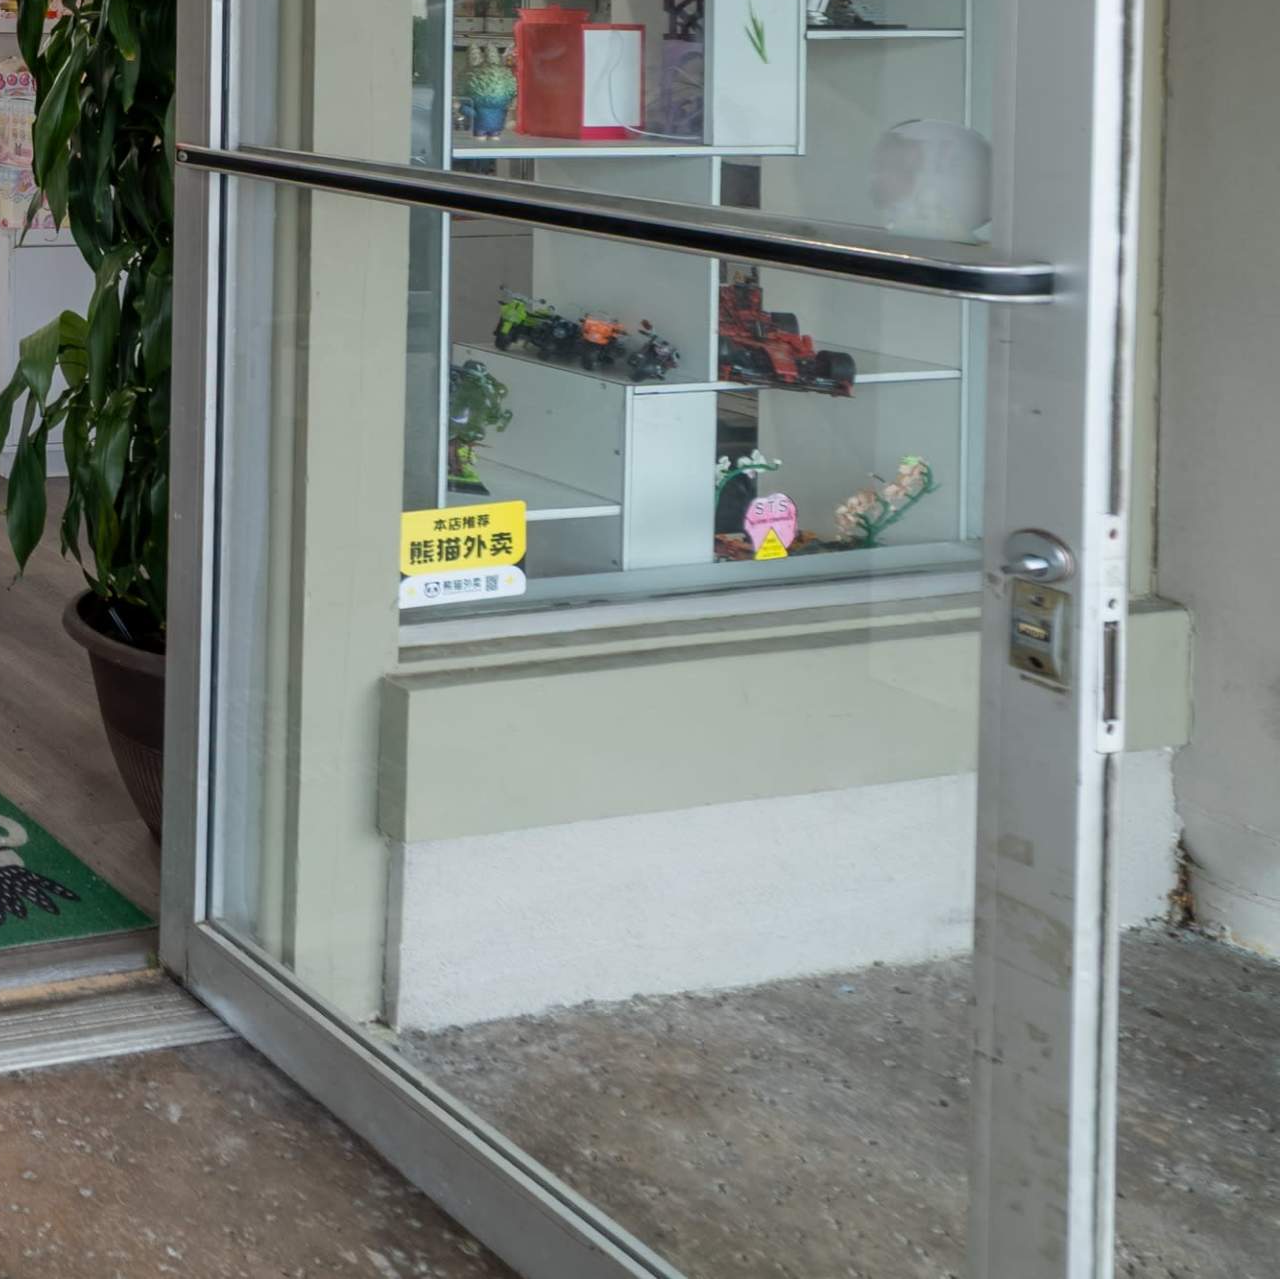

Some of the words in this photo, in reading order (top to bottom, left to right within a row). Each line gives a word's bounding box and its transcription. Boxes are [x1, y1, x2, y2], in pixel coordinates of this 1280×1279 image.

[755, 500, 788, 515] STS
[433, 514, 490, 532] 本店推荐
[409, 532, 513, 565] 熊猫外卖
